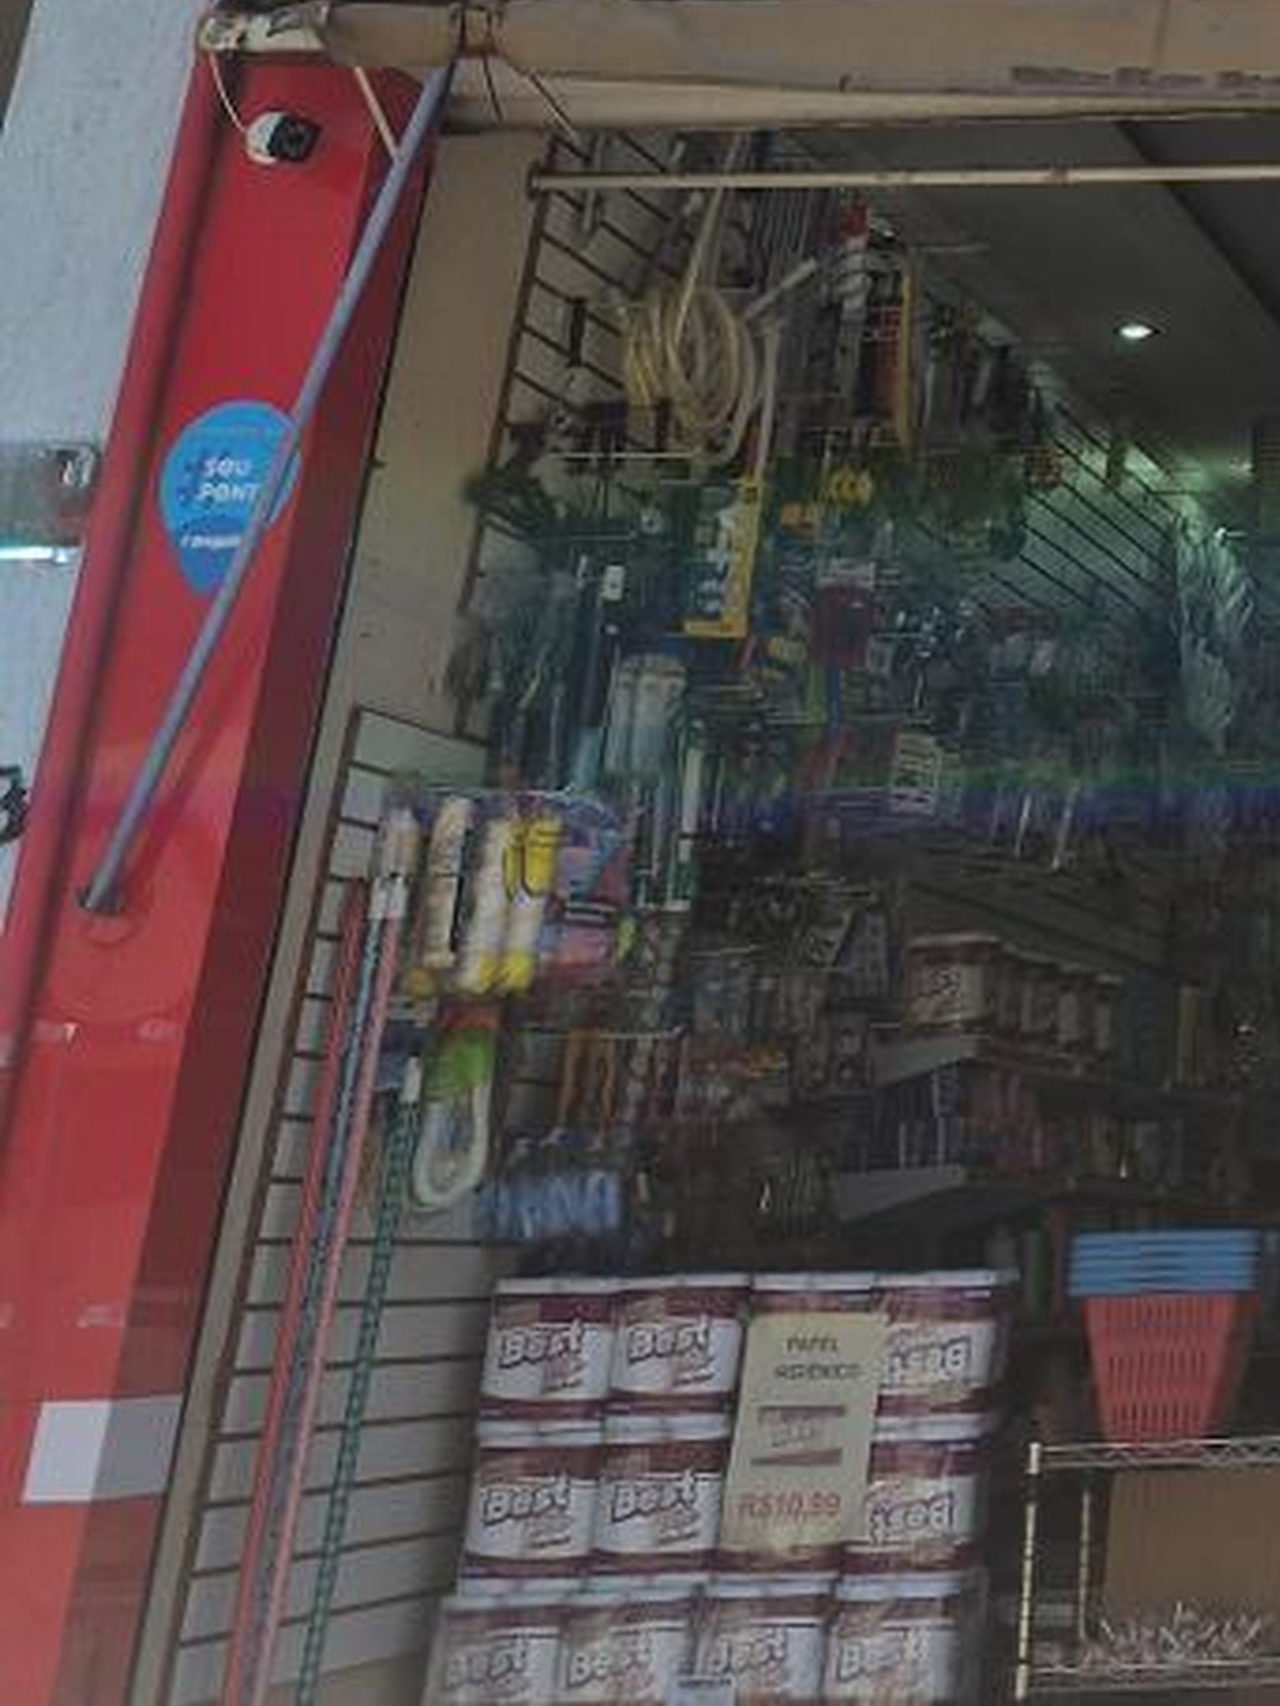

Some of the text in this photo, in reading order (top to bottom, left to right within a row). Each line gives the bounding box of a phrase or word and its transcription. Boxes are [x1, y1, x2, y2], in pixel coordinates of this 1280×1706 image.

[199, 483, 259, 502] PONT
[498, 1317, 585, 1369] Best
[626, 1314, 711, 1363] Best
[482, 1473, 572, 1526] Best
[610, 1469, 698, 1521] Best
